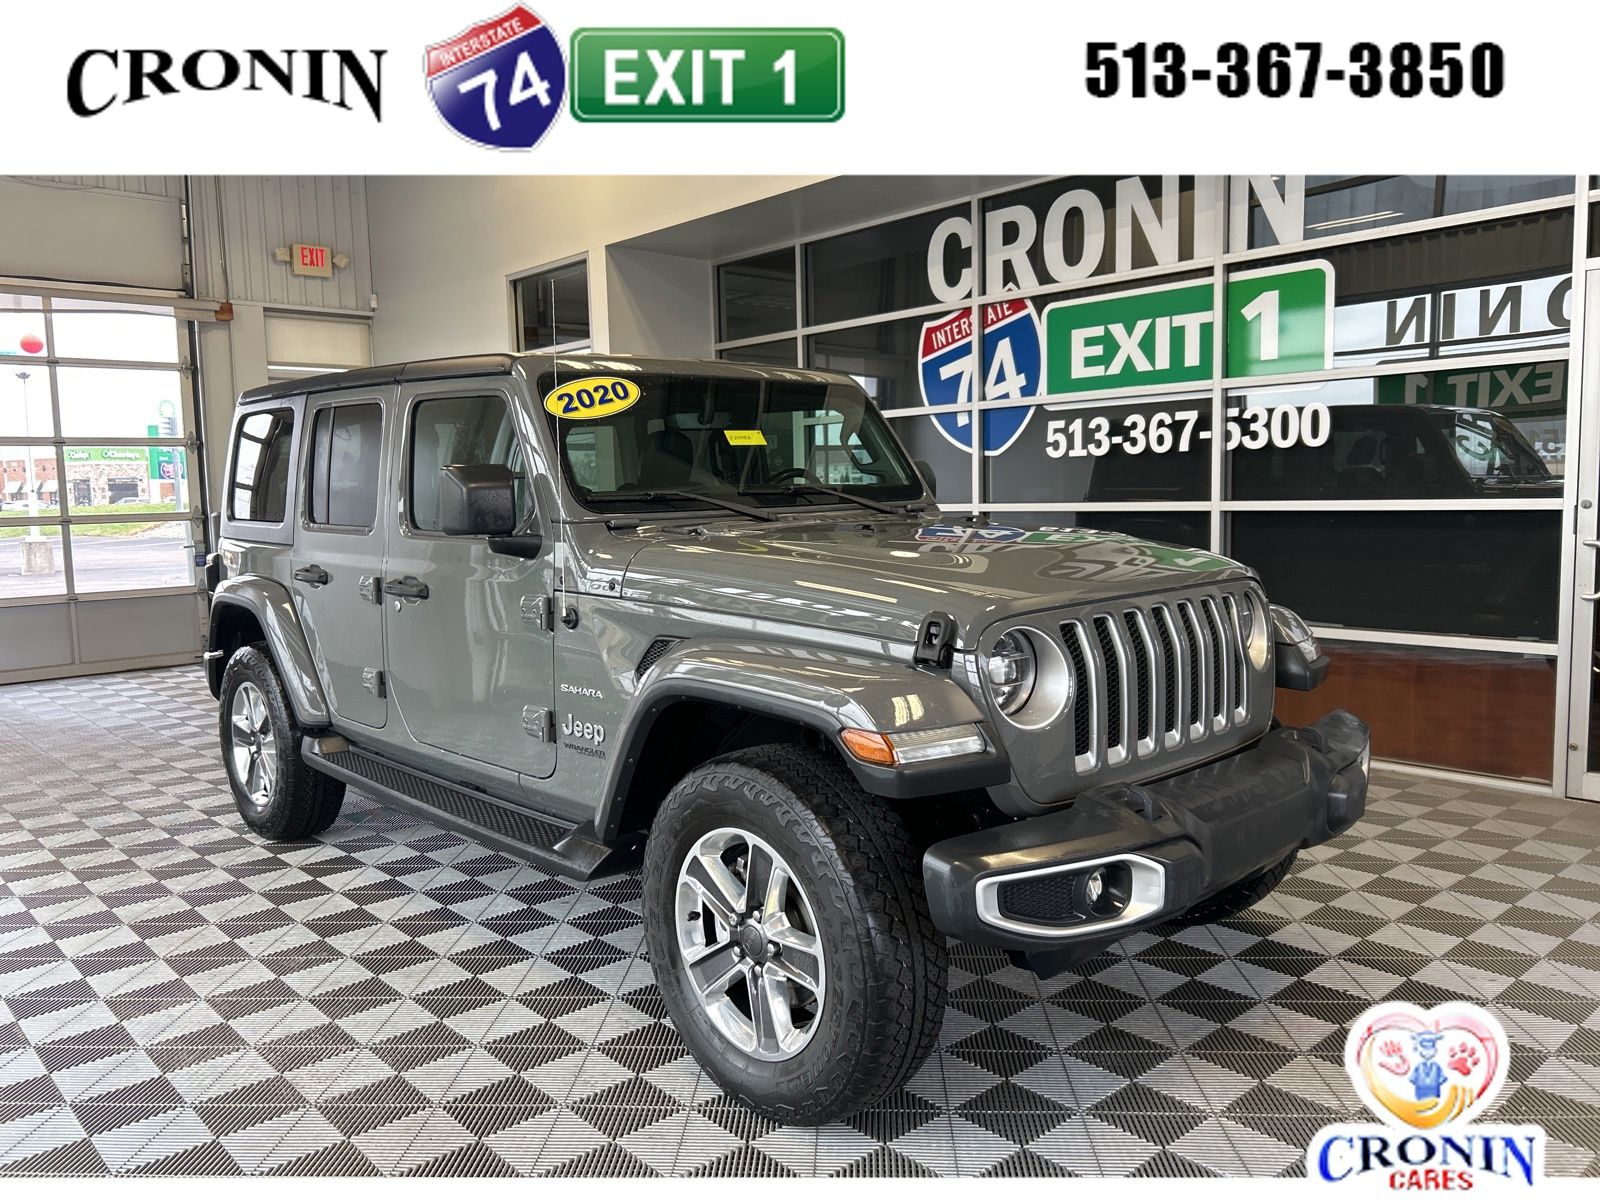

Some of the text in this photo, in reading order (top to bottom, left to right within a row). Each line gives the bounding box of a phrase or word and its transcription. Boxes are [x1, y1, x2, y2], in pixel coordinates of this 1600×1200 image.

[300, 246, 325, 267] EXIT
[927, 175, 1305, 303] CRONIN
[932, 302, 1014, 350] INTERATE
[1070, 289, 1280, 379] EXIT 1
[557, 381, 629, 414] 2020
[939, 337, 1027, 428] 74
[560, 683, 604, 699] SAHARA
[561, 713, 606, 746] Jeep
